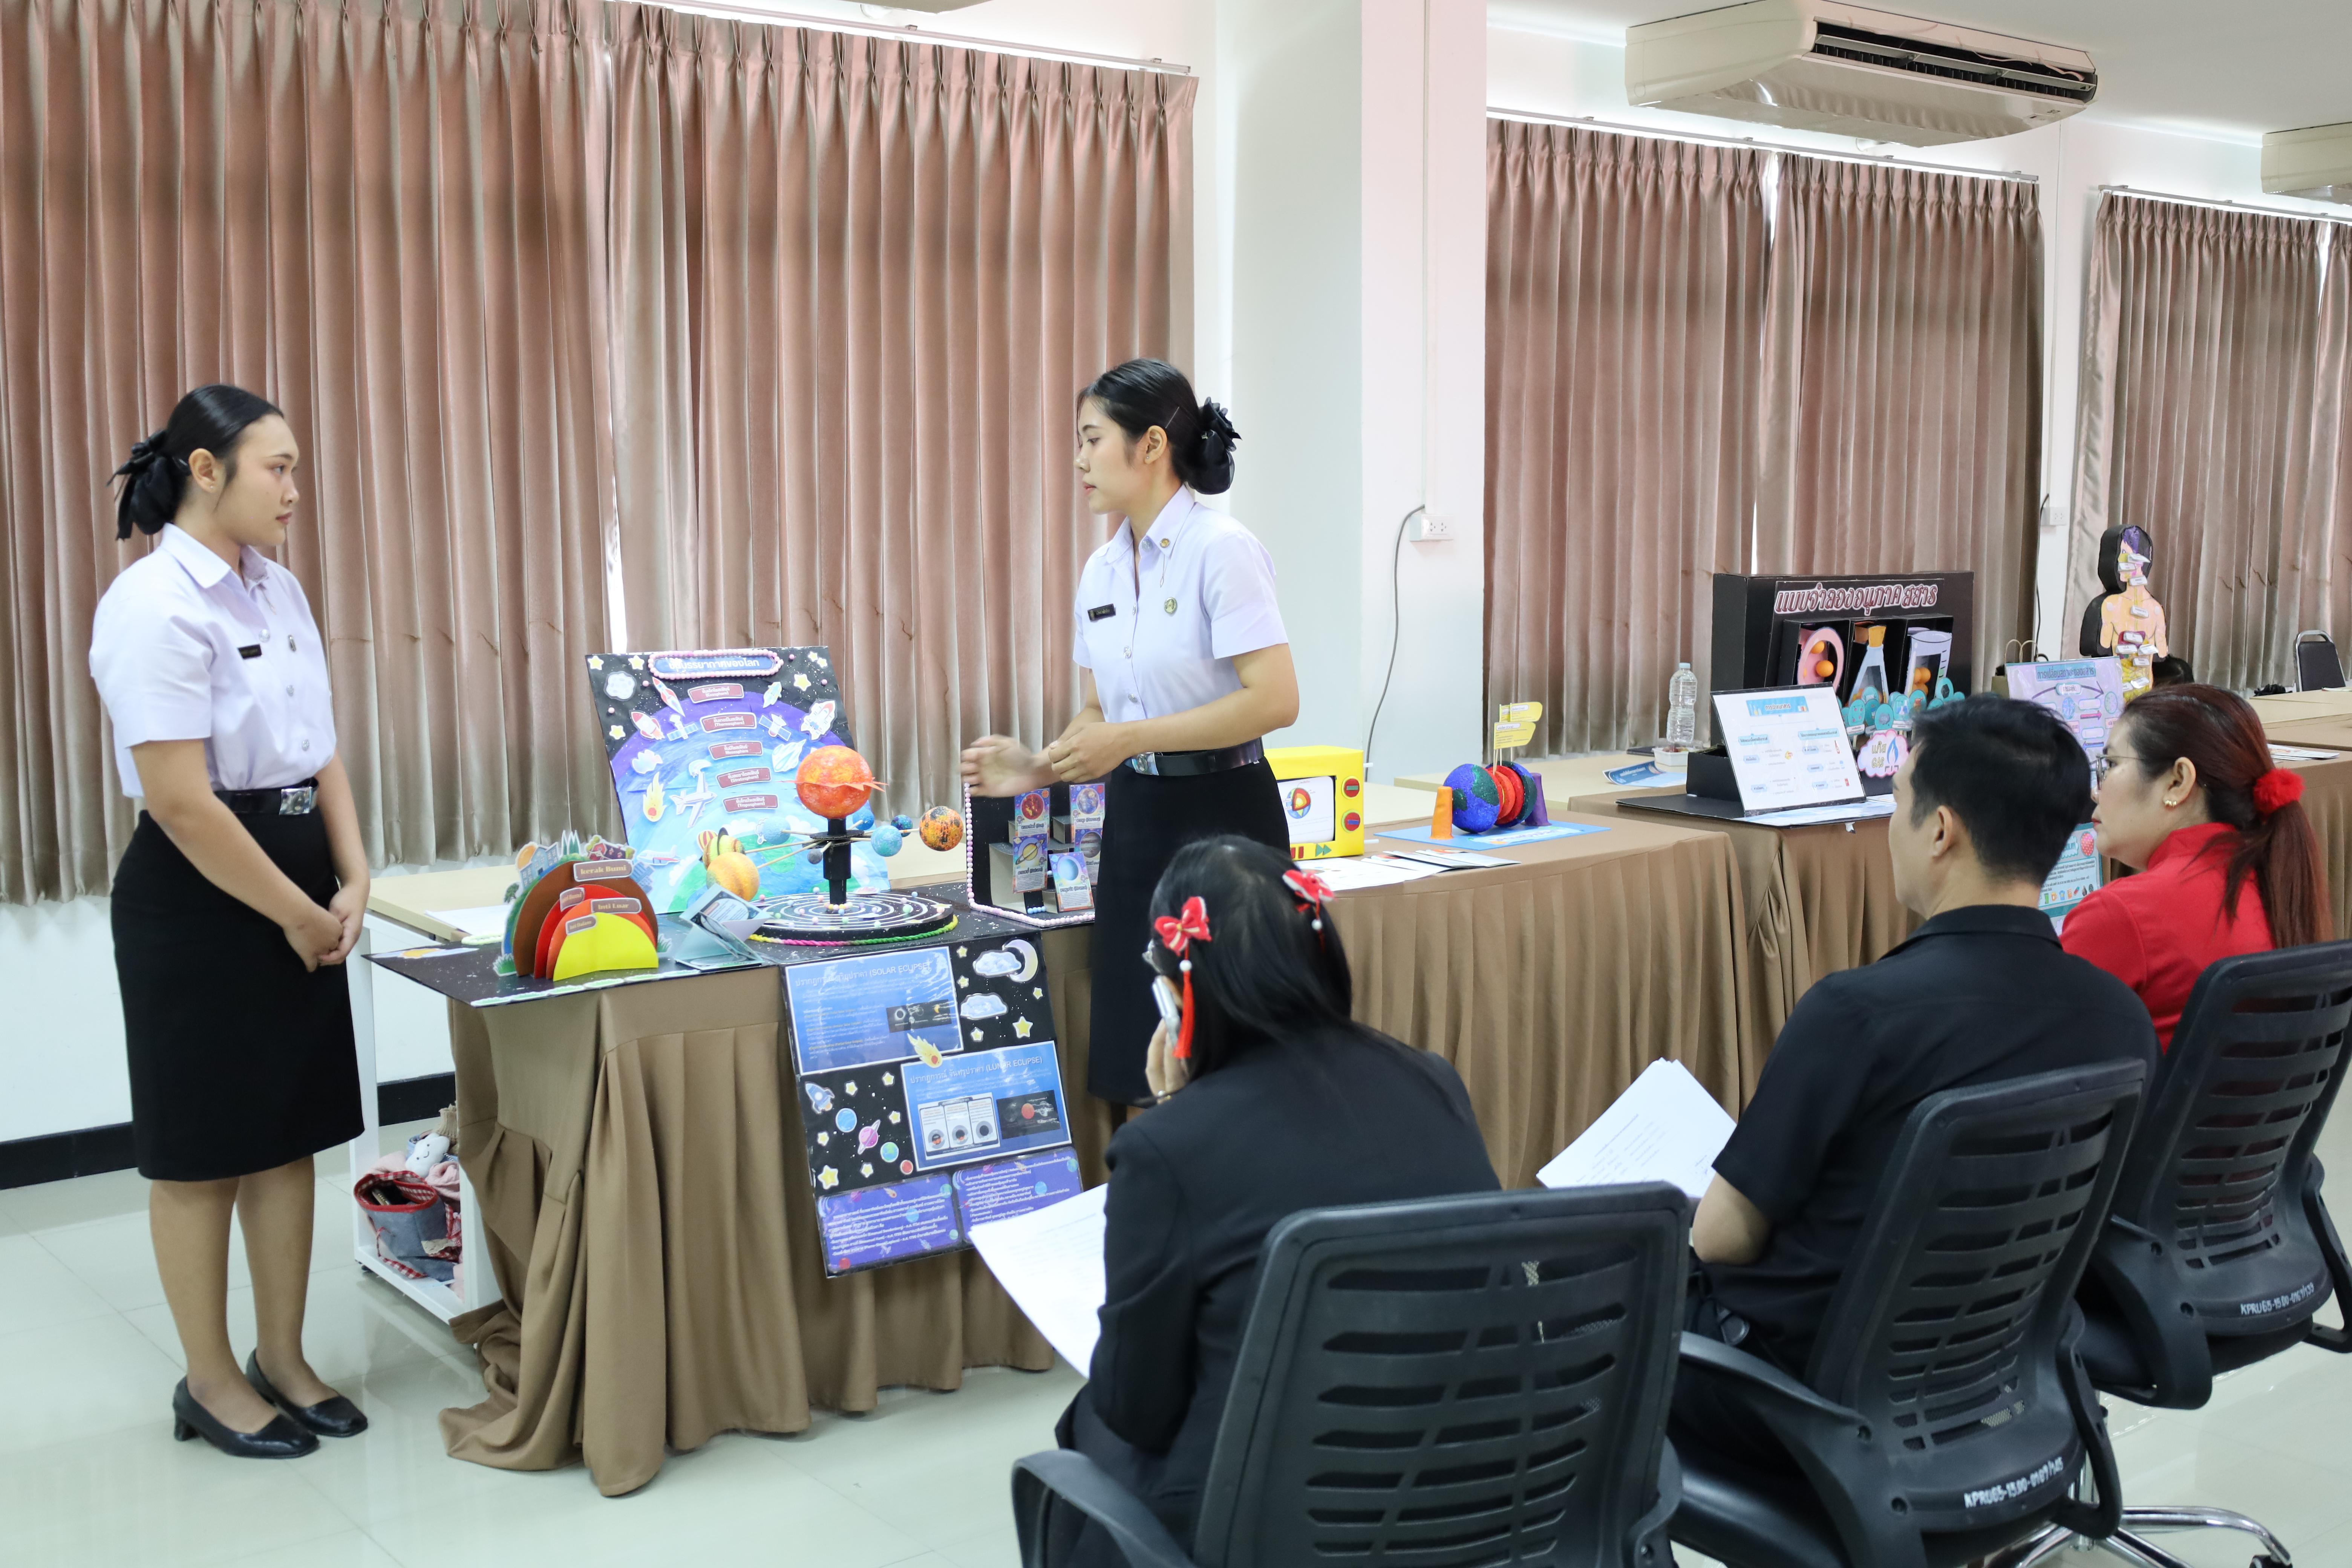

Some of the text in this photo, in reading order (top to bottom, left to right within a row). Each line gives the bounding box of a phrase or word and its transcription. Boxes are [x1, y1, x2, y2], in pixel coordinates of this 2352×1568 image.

[1871, 757, 1884, 768] GAS
[870, 966, 896, 978] (SOLAR
[1013, 1057, 1043, 1067] ECLIPSE)
